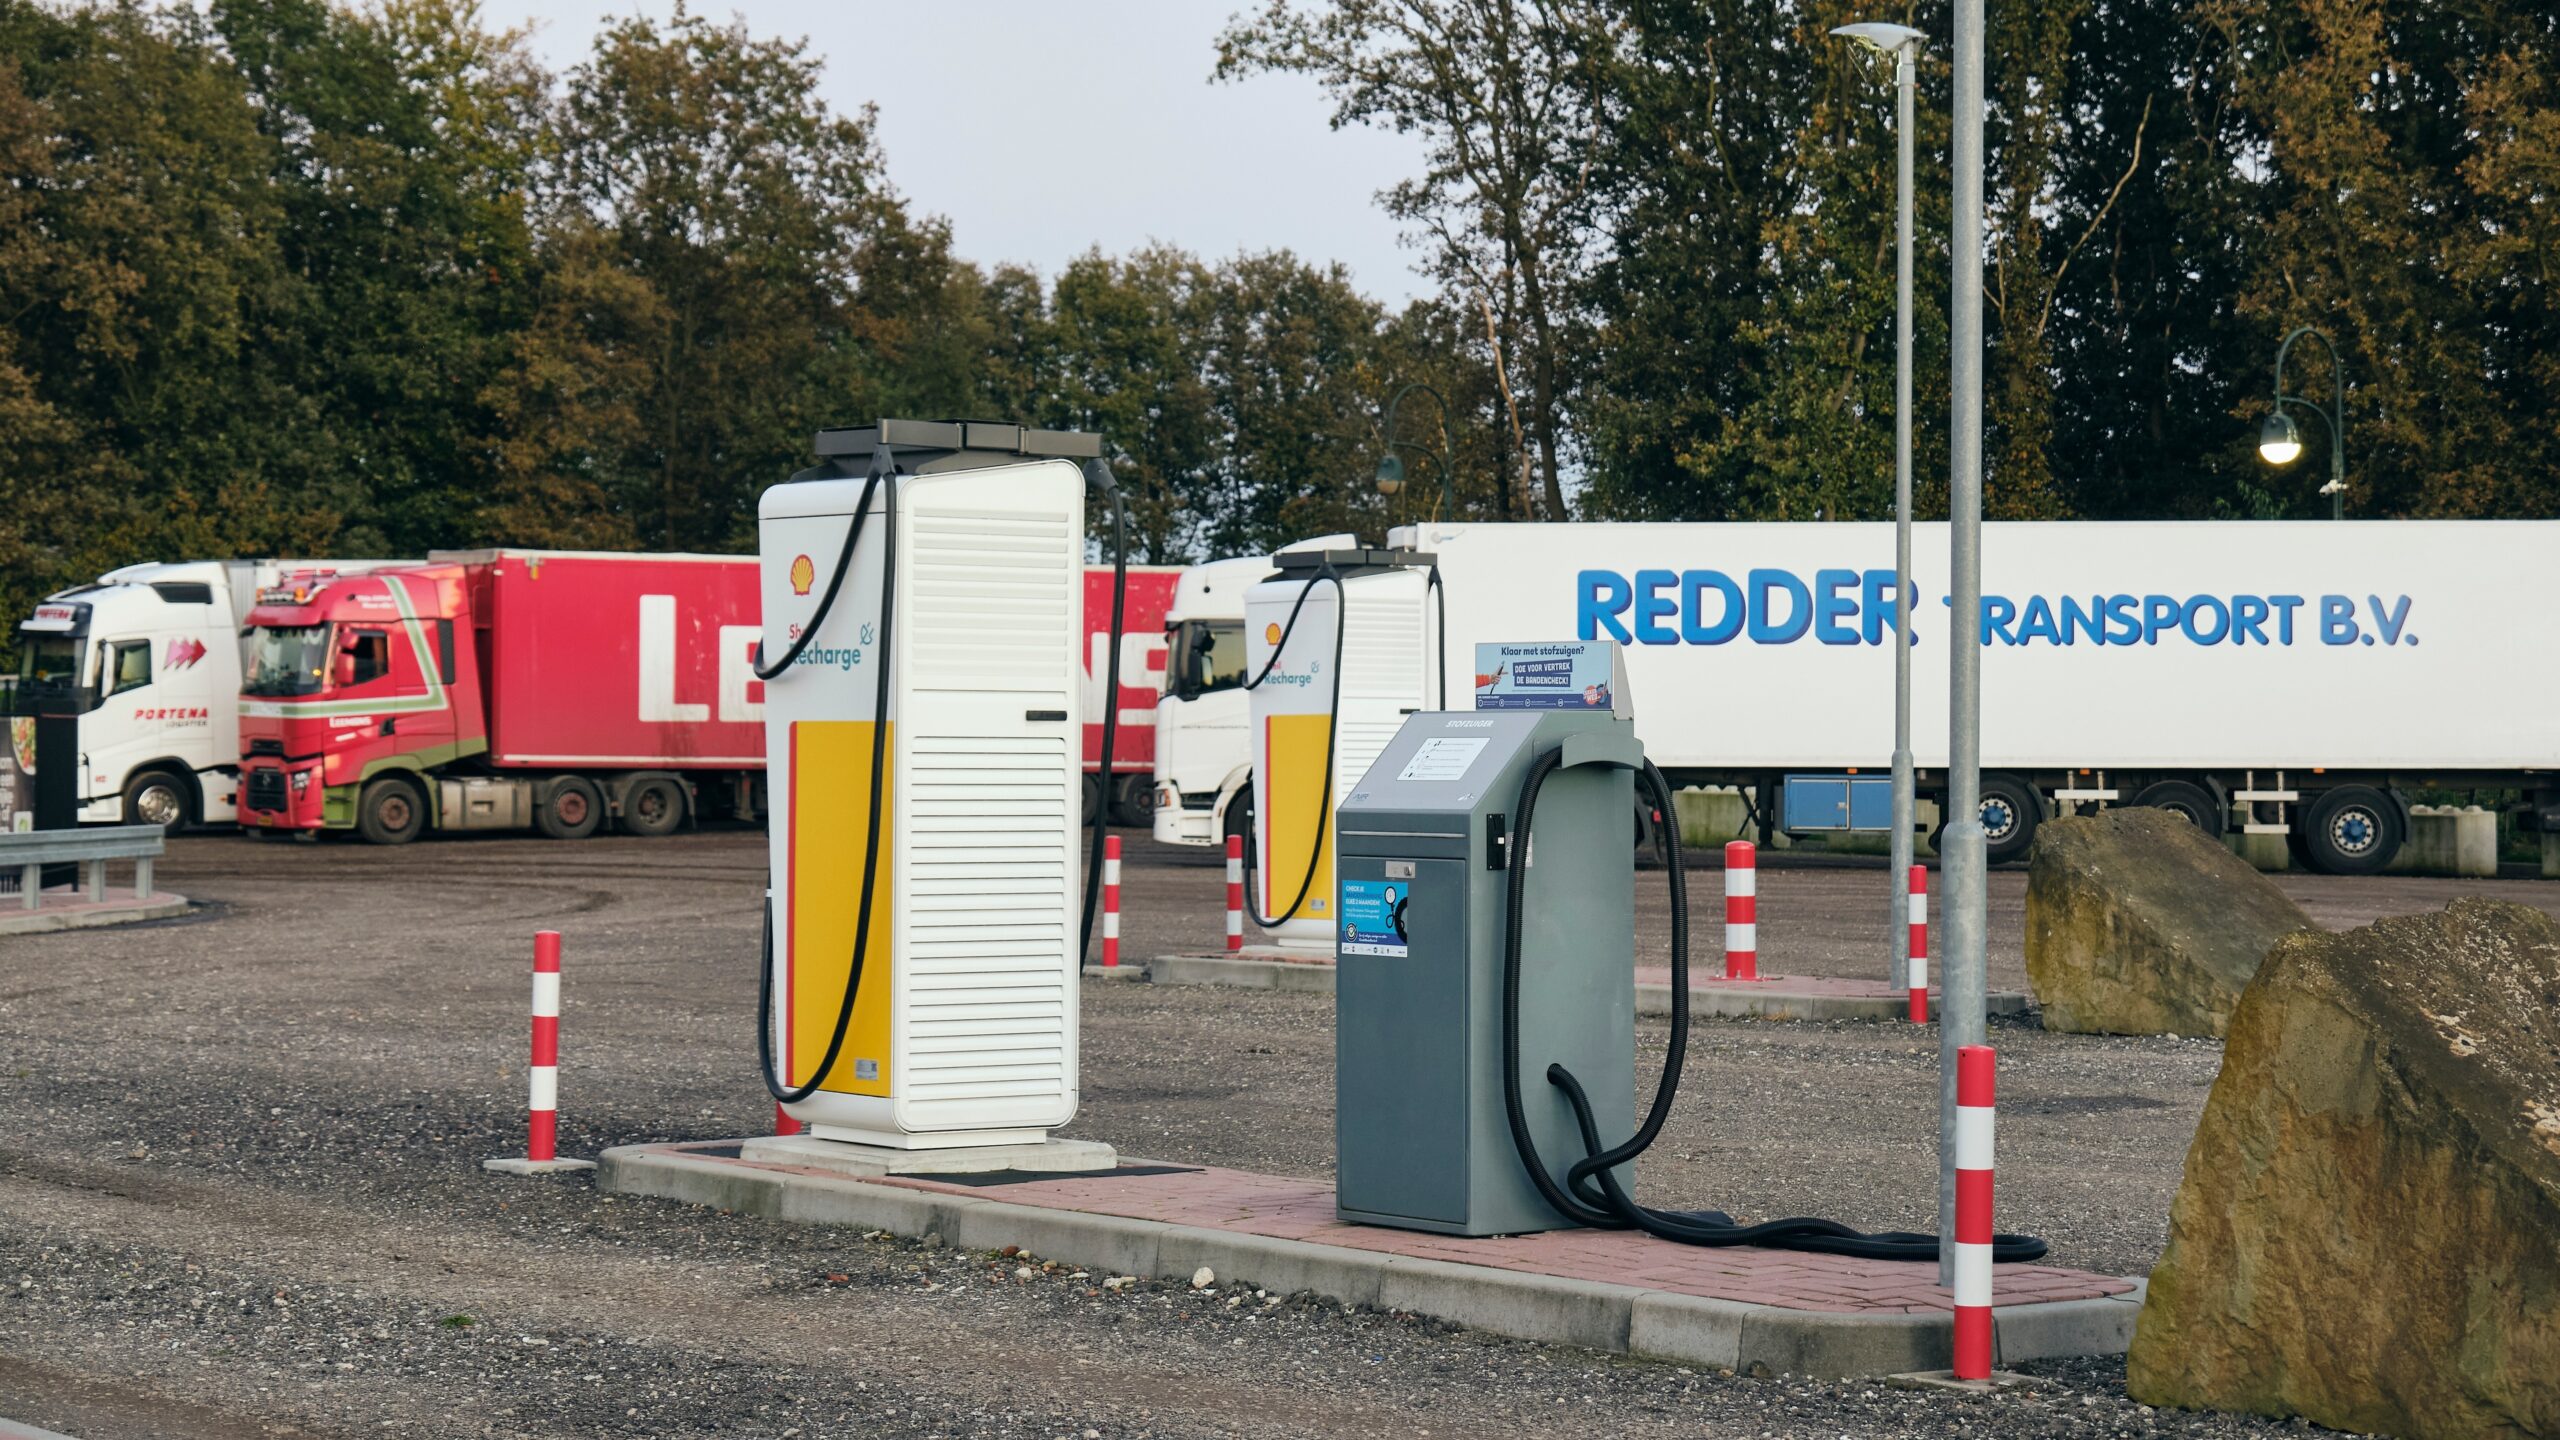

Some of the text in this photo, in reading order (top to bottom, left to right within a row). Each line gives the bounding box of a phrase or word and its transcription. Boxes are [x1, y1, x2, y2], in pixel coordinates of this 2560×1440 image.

[1577, 568, 2419, 646] REDDER RANSPORT B.V.
[1501, 645, 1585, 657] Klaar met stofzuigen?
[1514, 662, 1571, 673] DOE VOOR VERTREK
[1516, 676, 1569, 685] DE BANDENCHECK!
[134, 707, 208, 720] PORTENA
[1445, 719, 1494, 728] STOFZUIGER
